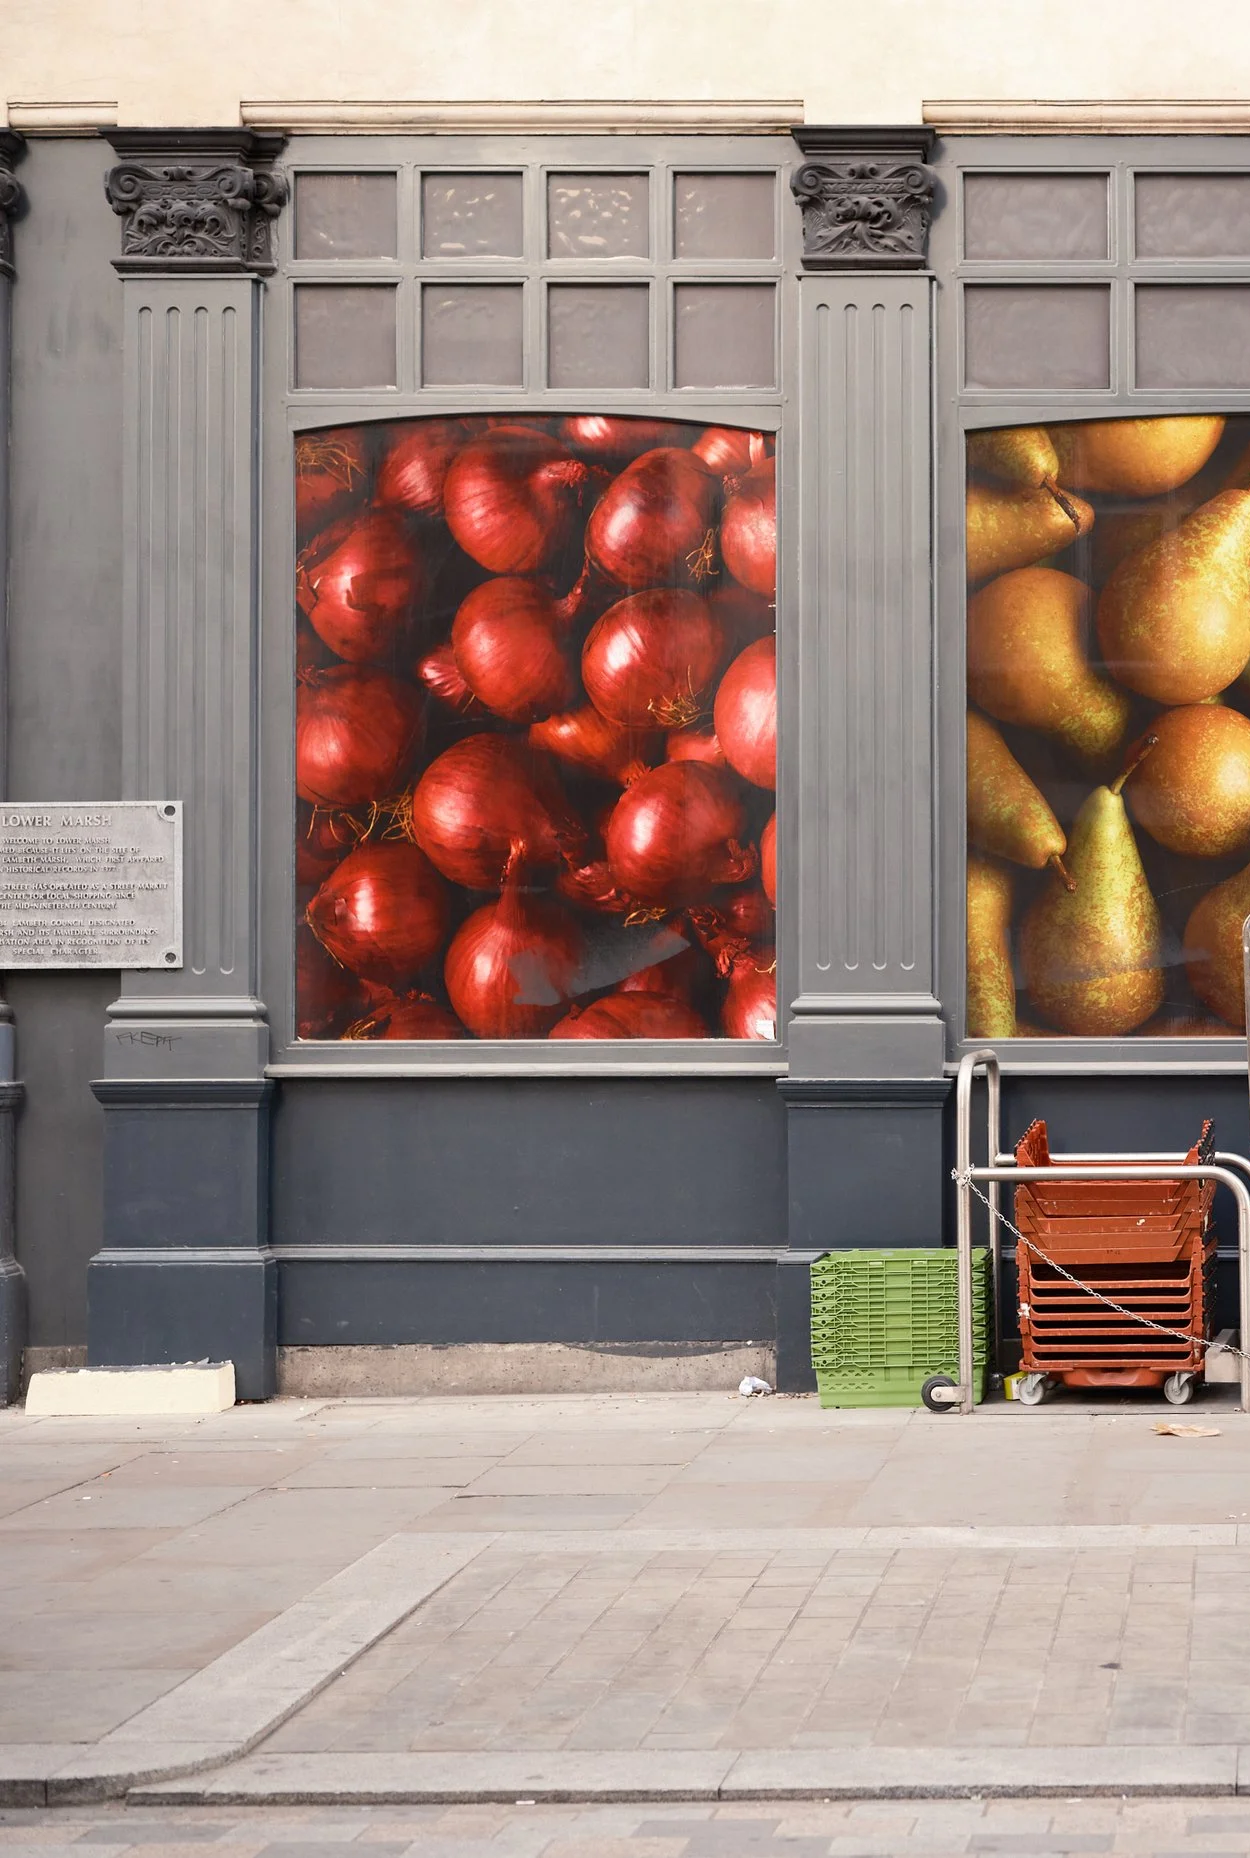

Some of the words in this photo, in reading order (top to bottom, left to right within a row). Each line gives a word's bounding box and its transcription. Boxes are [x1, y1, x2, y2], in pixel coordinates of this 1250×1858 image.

[2, 815, 52, 827] LOWER
[60, 815, 112, 827] MARSH
[100, 929, 158, 937] SURROUNDINGS
[51, 948, 98, 956] CHARACTER
